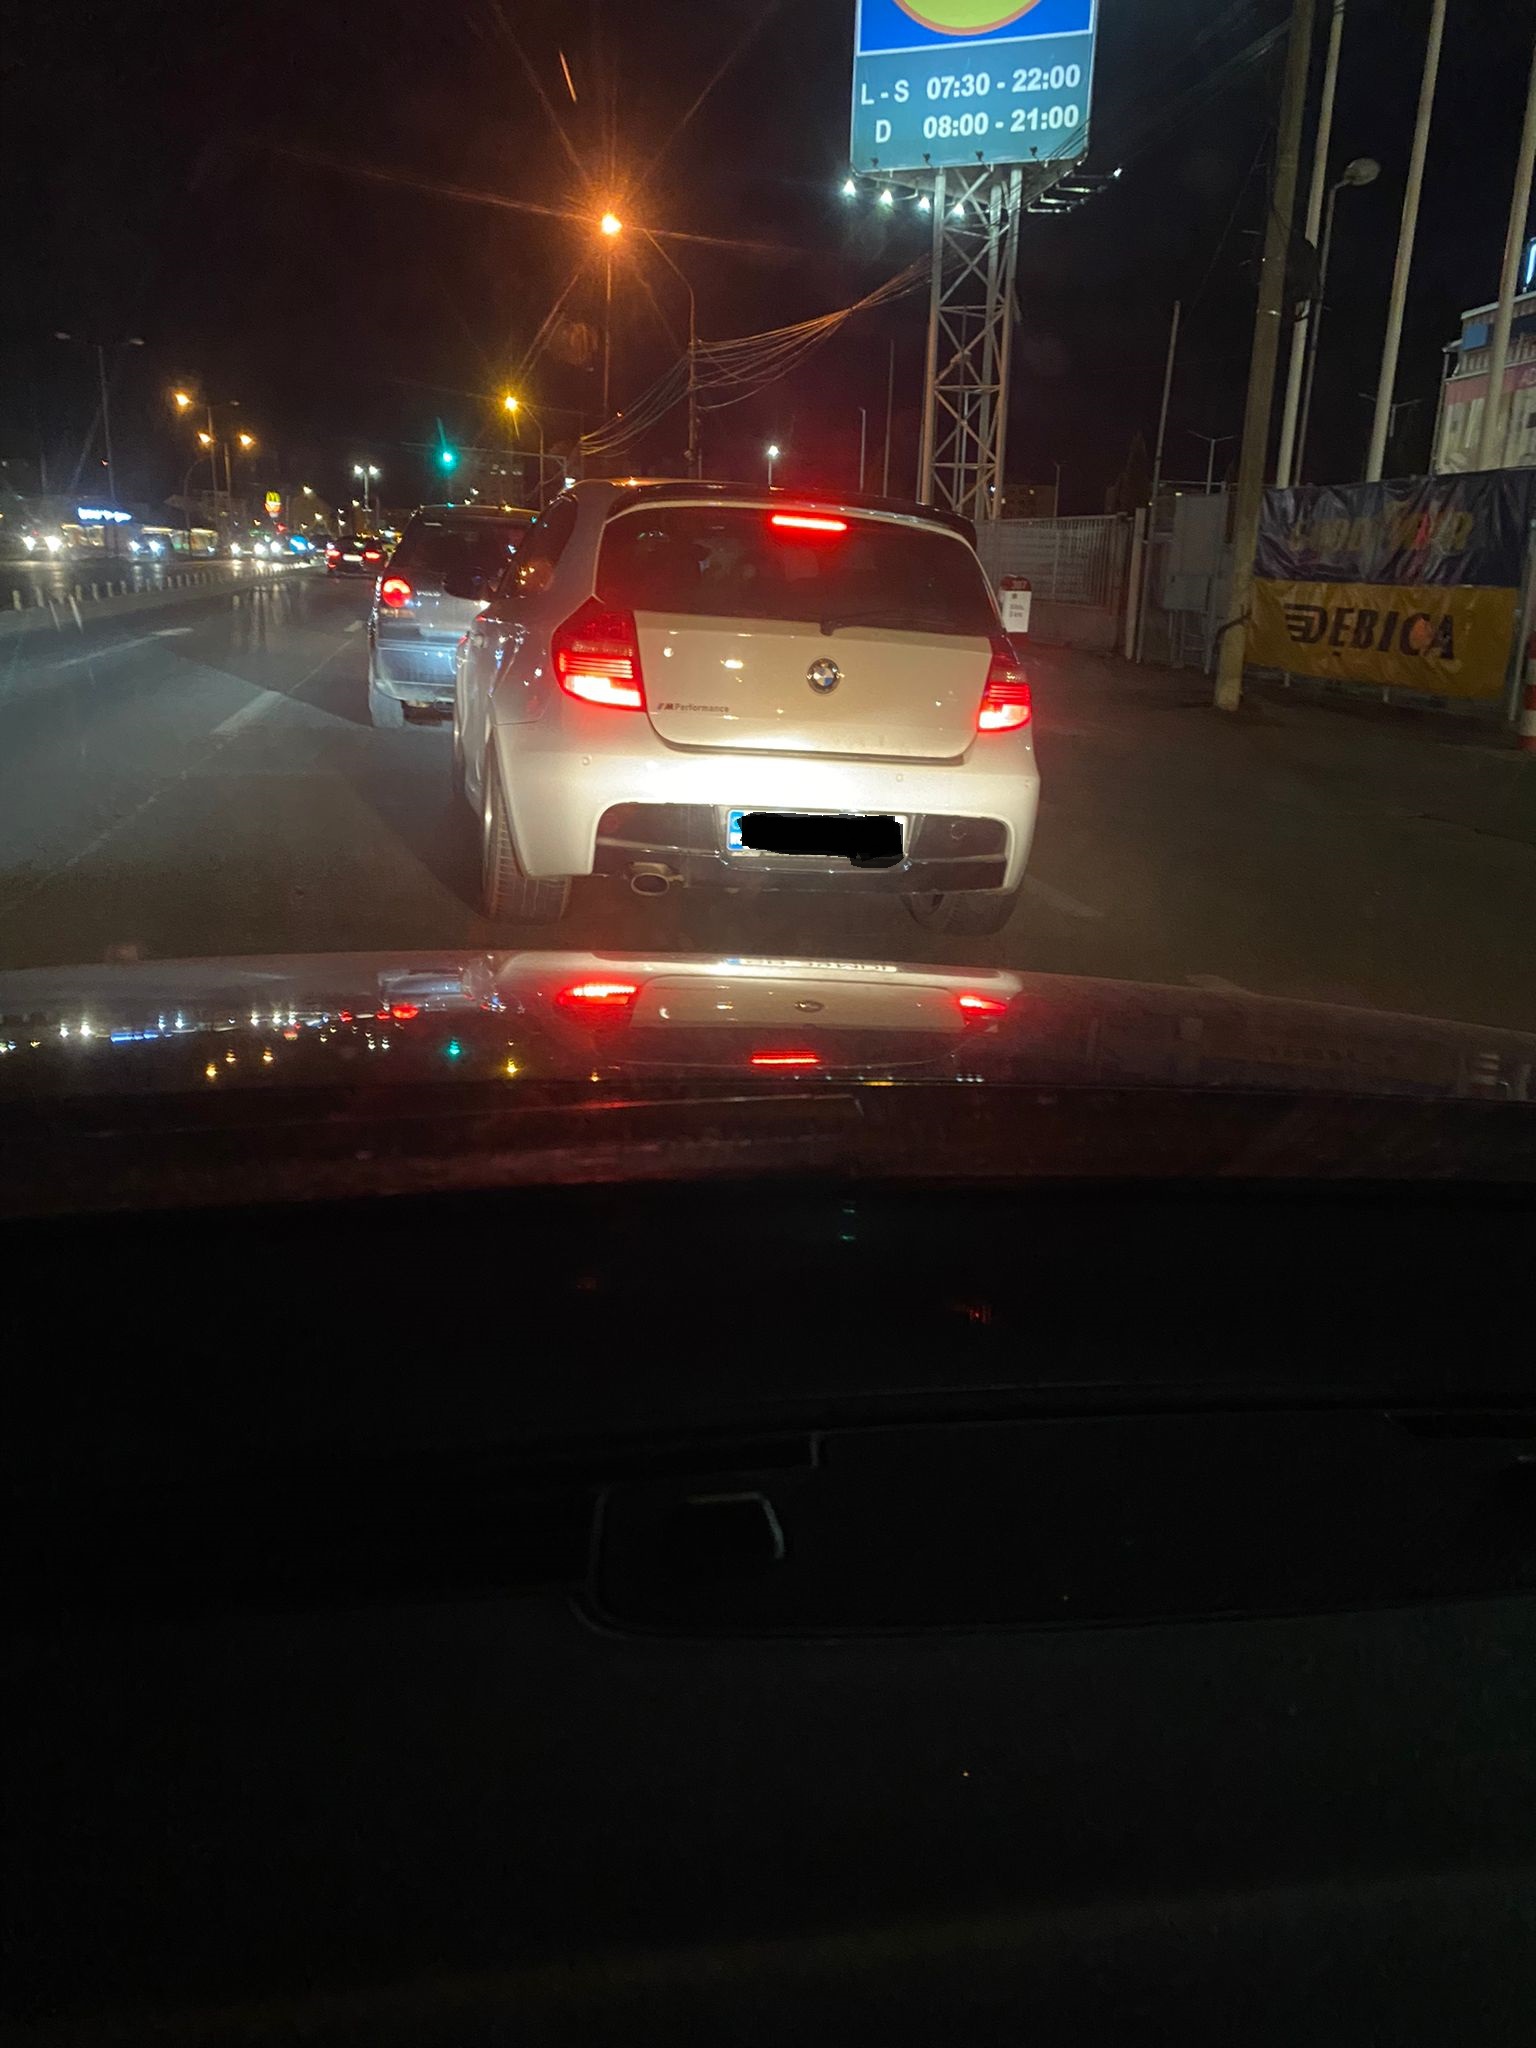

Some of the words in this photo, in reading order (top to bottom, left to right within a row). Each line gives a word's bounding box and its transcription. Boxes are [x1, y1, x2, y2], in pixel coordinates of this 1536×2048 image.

[861, 83, 874, 105] L
[894, 79, 910, 103] S
[926, 72, 991, 100] 07:30
[1011, 64, 1081, 93] 22:00
[875, 119, 891, 143] D
[923, 112, 989, 139] 08:00
[1009, 104, 1079, 132] 21:00
